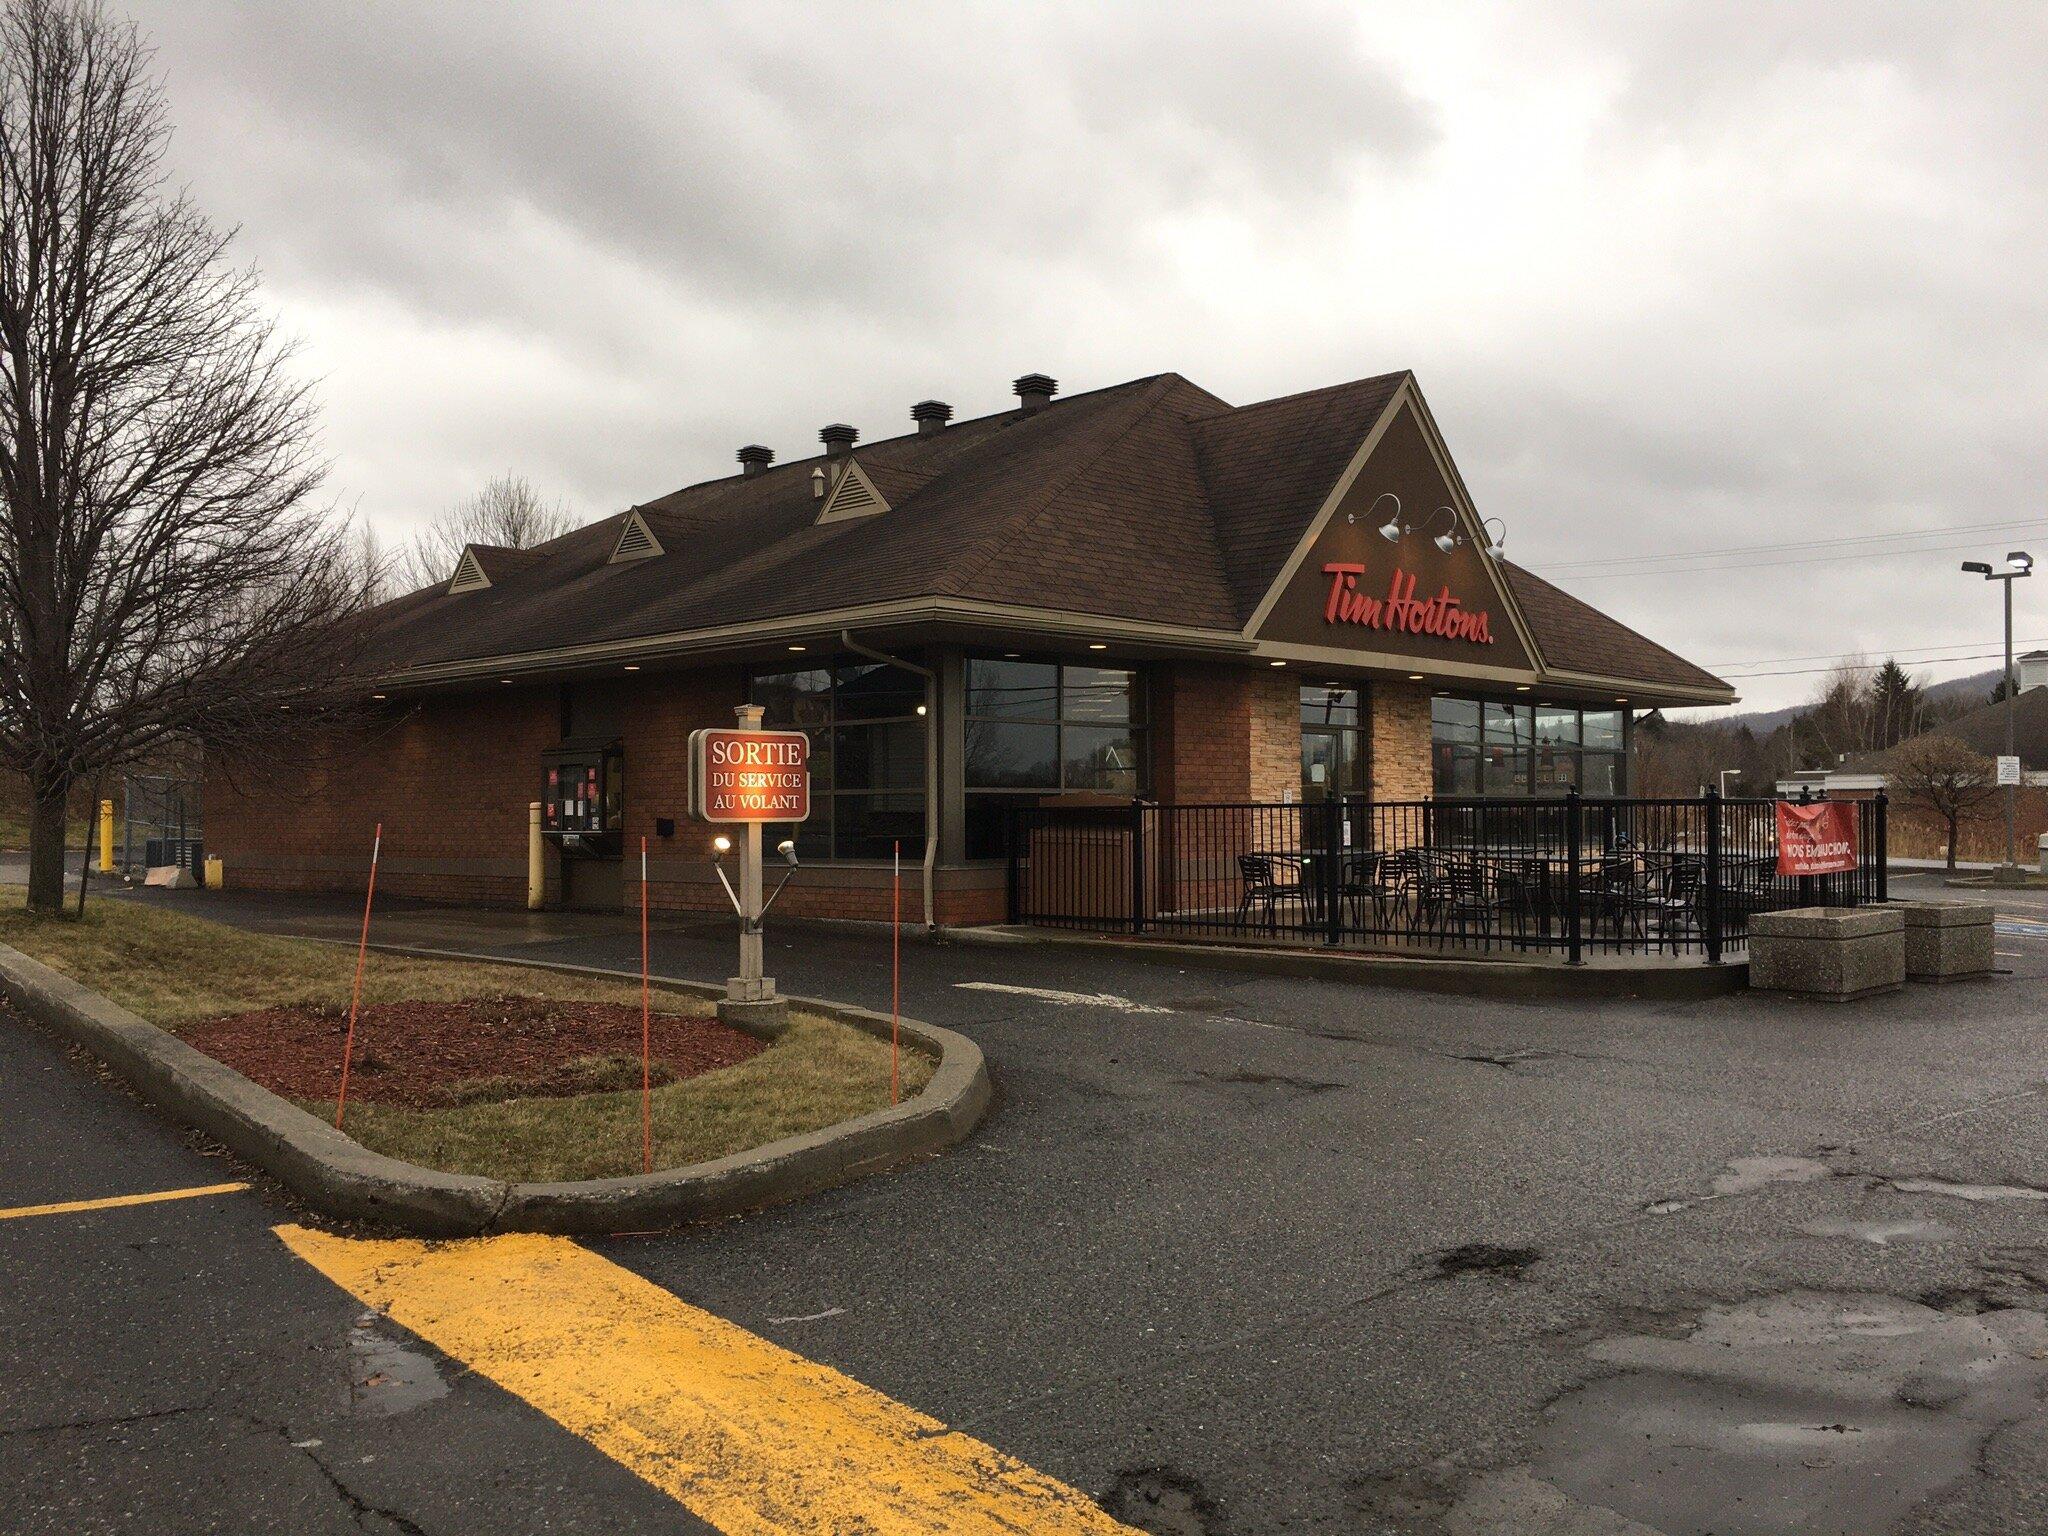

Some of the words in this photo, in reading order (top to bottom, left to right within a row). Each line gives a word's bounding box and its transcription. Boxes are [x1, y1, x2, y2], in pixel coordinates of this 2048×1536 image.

[1322, 562, 1383, 630] Tim
[712, 741, 802, 766] SORTIE
[712, 772, 735, 787] DU
[738, 772, 802, 788] SERVICE
[713, 794, 736, 809] AU
[739, 794, 800, 810] VOLANT
